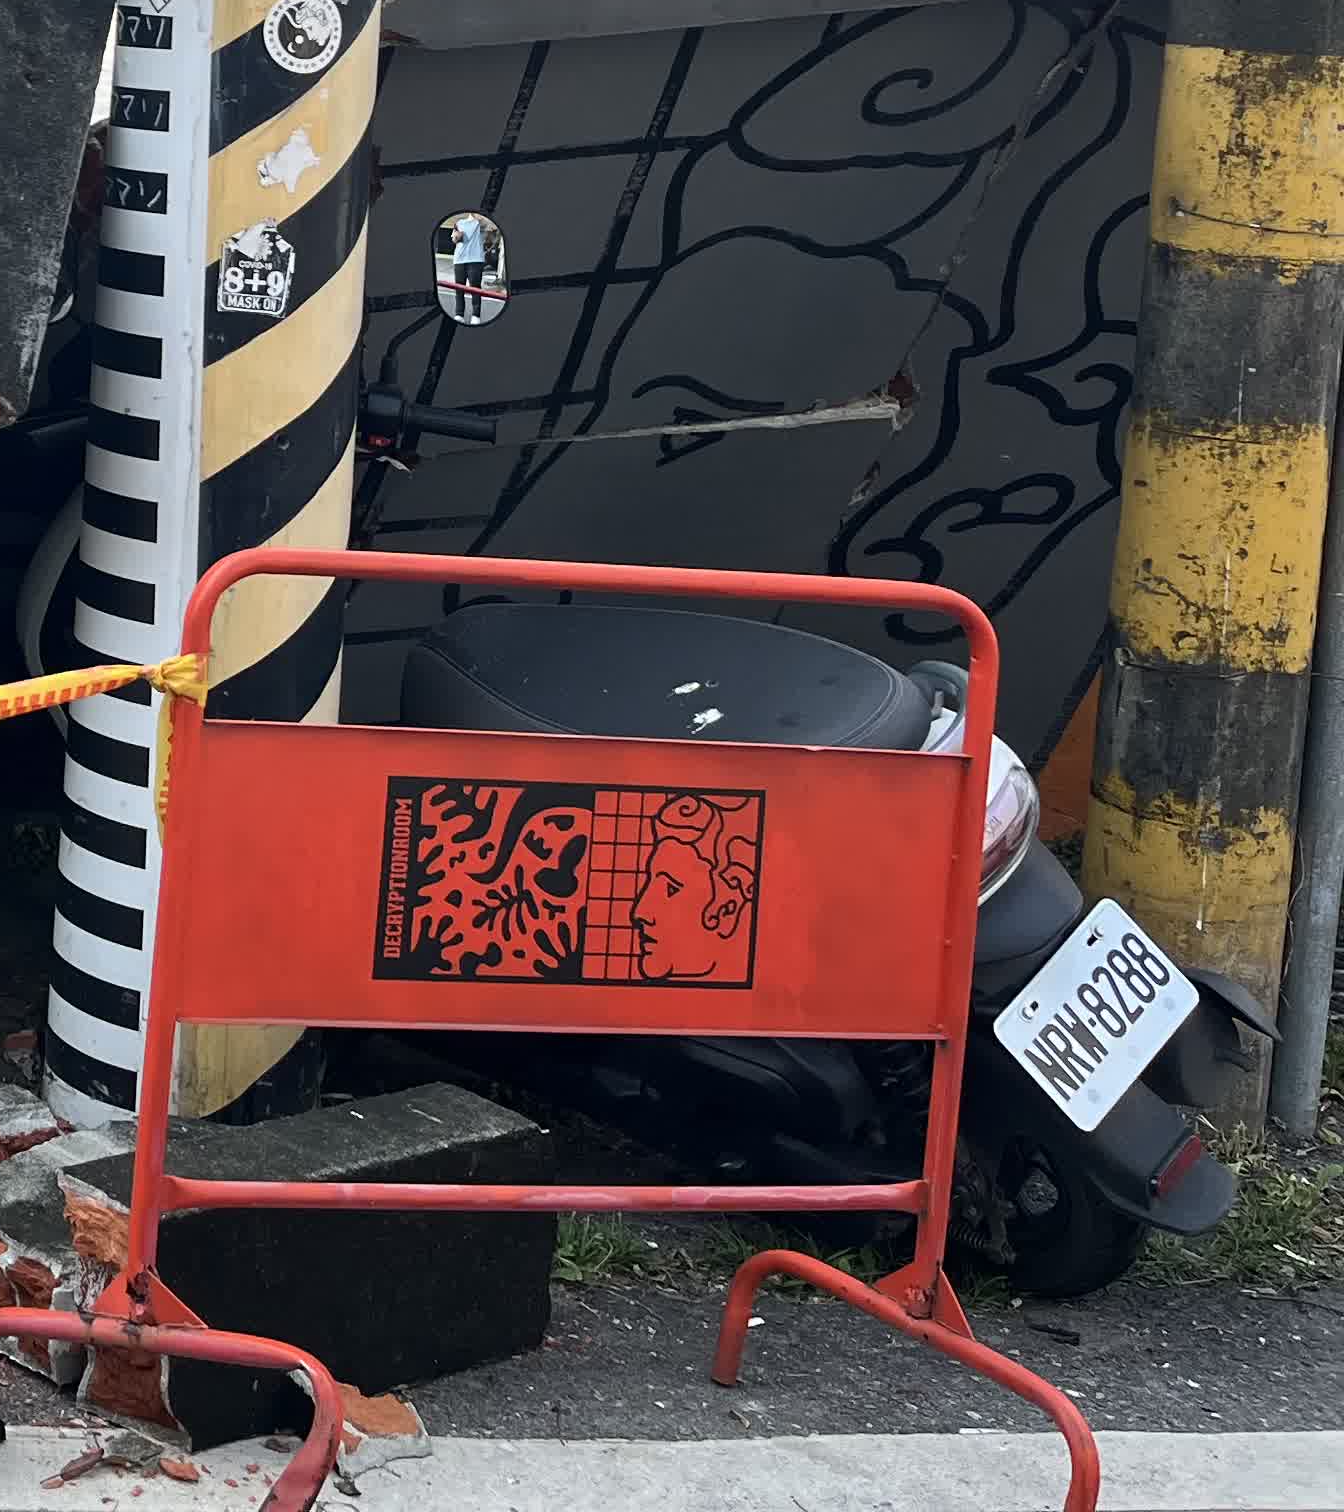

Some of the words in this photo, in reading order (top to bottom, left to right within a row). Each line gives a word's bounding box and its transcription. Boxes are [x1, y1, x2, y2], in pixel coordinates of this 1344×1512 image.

[224, 266, 285, 297] 8+9
[227, 294, 261, 310] MASK
[263, 298, 278, 312] ON
[382, 797, 414, 960] DECRYPTIONROOM
